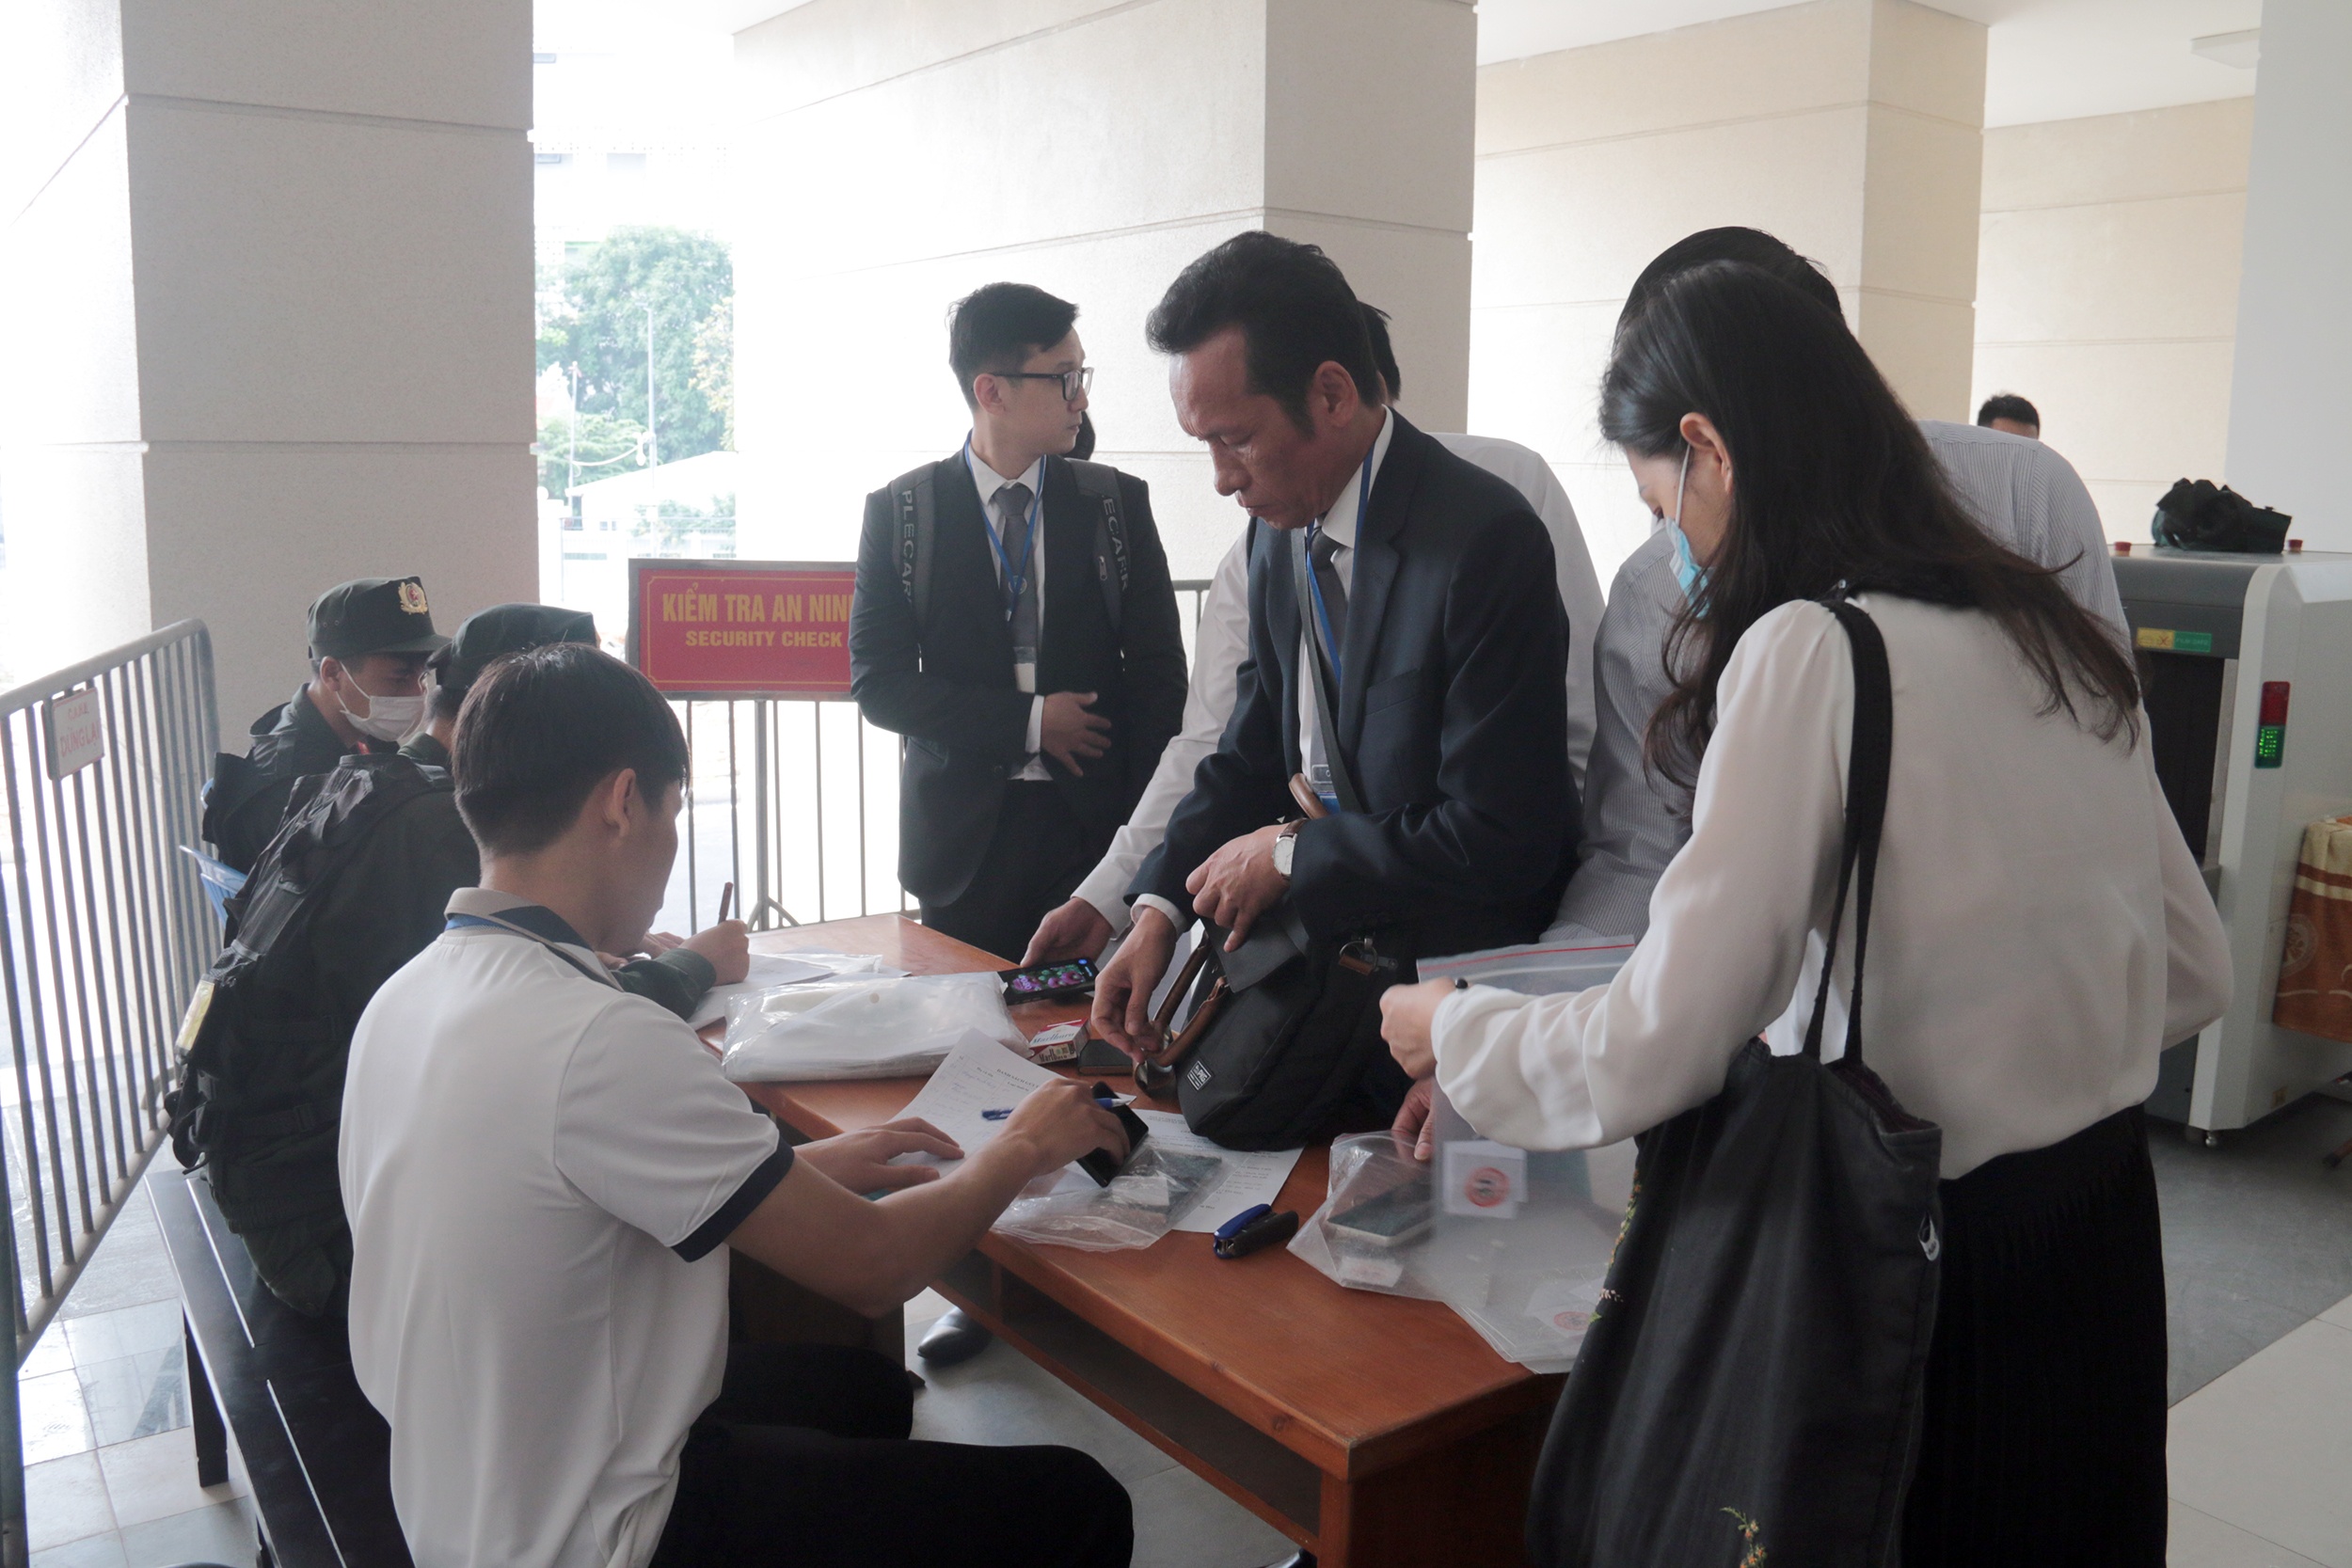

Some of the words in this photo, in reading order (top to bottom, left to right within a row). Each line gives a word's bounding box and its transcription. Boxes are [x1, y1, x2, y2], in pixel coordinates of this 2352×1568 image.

[901, 489, 914, 603] PLECAR
[662, 582, 718, 623] KIỂM
[724, 594, 766, 623] TRA
[771, 594, 801, 623] AN
[685, 630, 776, 647] SECURITY
[782, 630, 843, 647] CHECK
[1033, 1032, 1075, 1044] Marlboro
